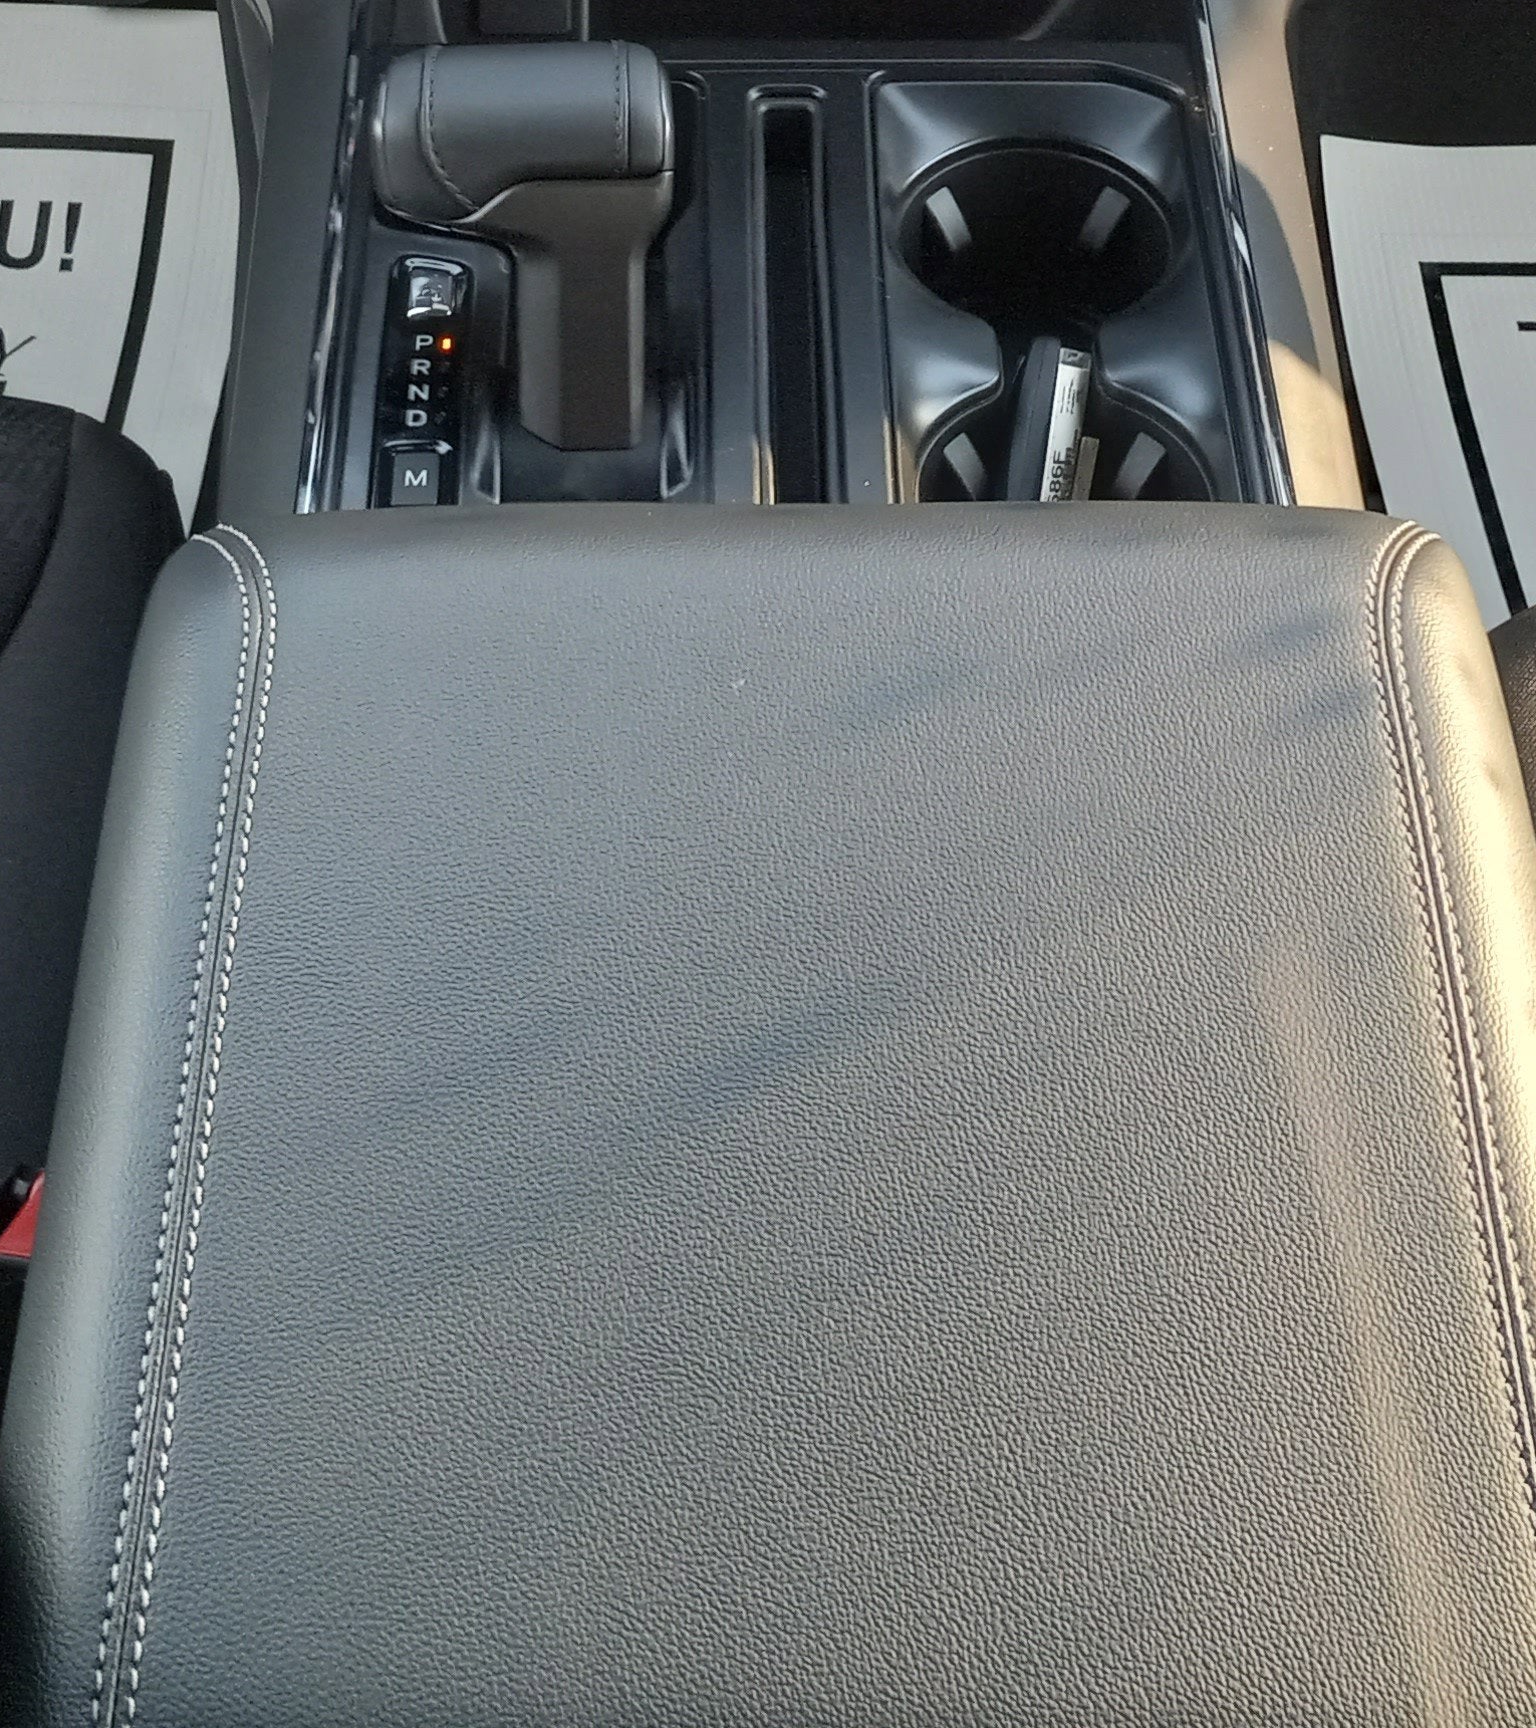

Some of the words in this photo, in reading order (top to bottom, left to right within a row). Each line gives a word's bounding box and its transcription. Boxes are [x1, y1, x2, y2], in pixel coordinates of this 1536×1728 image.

[415, 335, 434, 351] P
[411, 359, 432, 376] R
[407, 384, 430, 402] N
[405, 409, 428, 427] D
[404, 469, 428, 486] M
